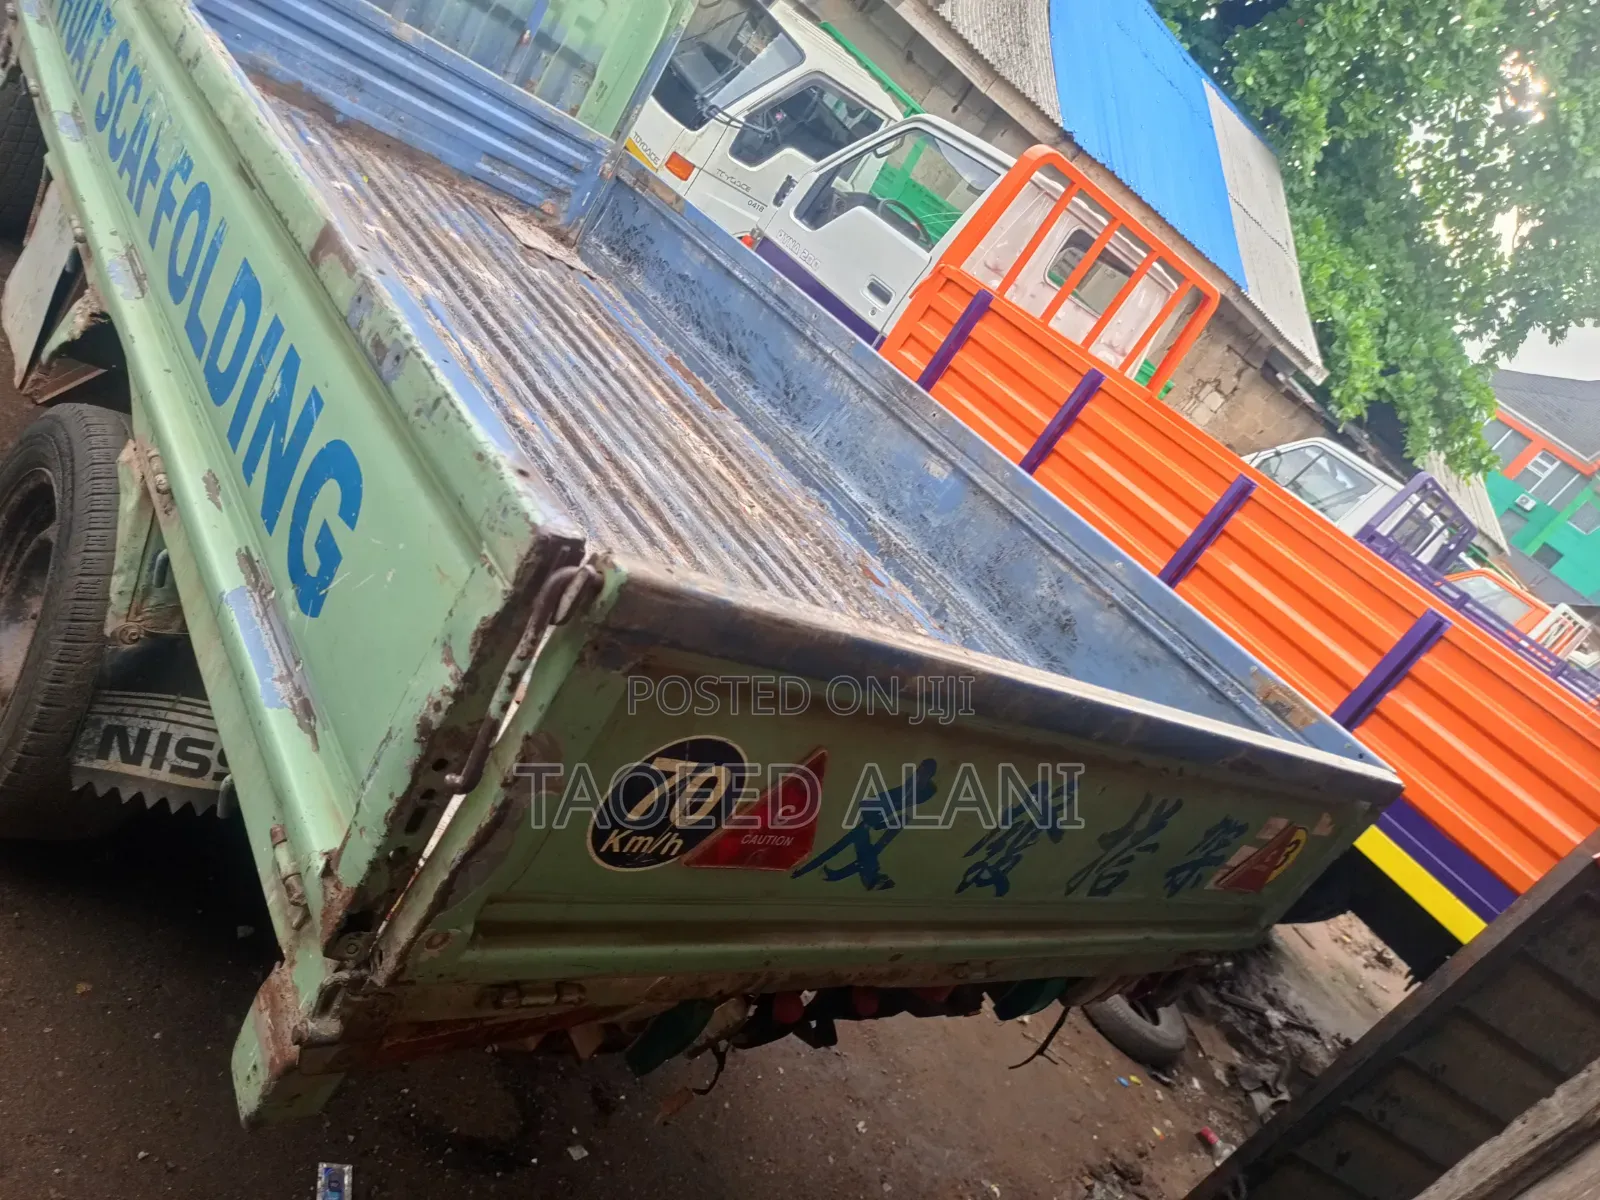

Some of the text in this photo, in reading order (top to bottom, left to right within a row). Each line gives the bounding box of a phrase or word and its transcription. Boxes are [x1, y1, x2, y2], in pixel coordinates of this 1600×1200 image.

[633, 131, 661, 165] TOYOACE
[747, 200, 765, 213] 0418
[776, 228, 801, 256] DYNA
[95, 39, 363, 618] SCAFFOLDING
[624, 756, 731, 826] 70
[599, 829, 685, 857] Km/h
[740, 833, 795, 847] CAUTION
